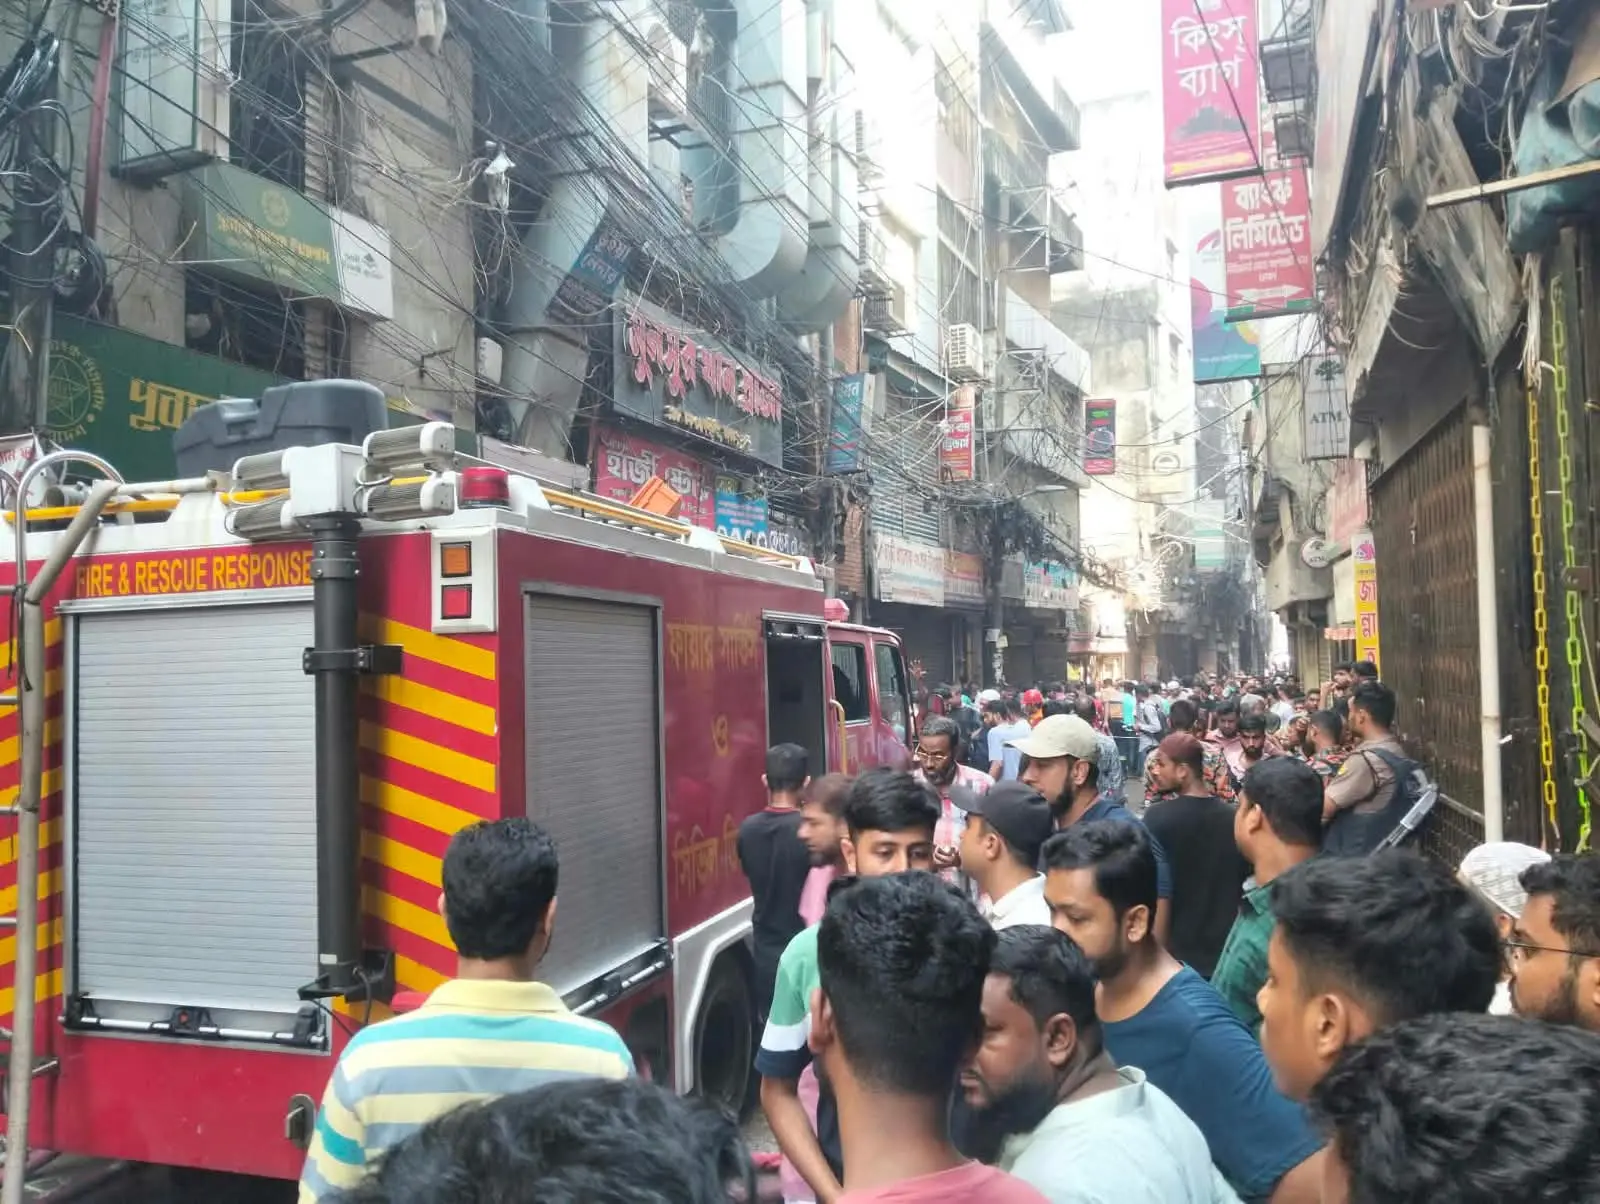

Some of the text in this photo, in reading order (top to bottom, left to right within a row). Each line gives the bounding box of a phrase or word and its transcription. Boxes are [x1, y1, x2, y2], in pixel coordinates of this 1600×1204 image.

[1175, 55, 1245, 97] ব্যাগ
[1233, 177, 1293, 211] ব্যাংক
[1225, 211, 1307, 252] লিমিটেড
[129, 377, 216, 431] পূবা
[1310, 411, 1344, 425] ATM
[76, 550, 312, 598] FIRE & RESCUE RESPONSE
